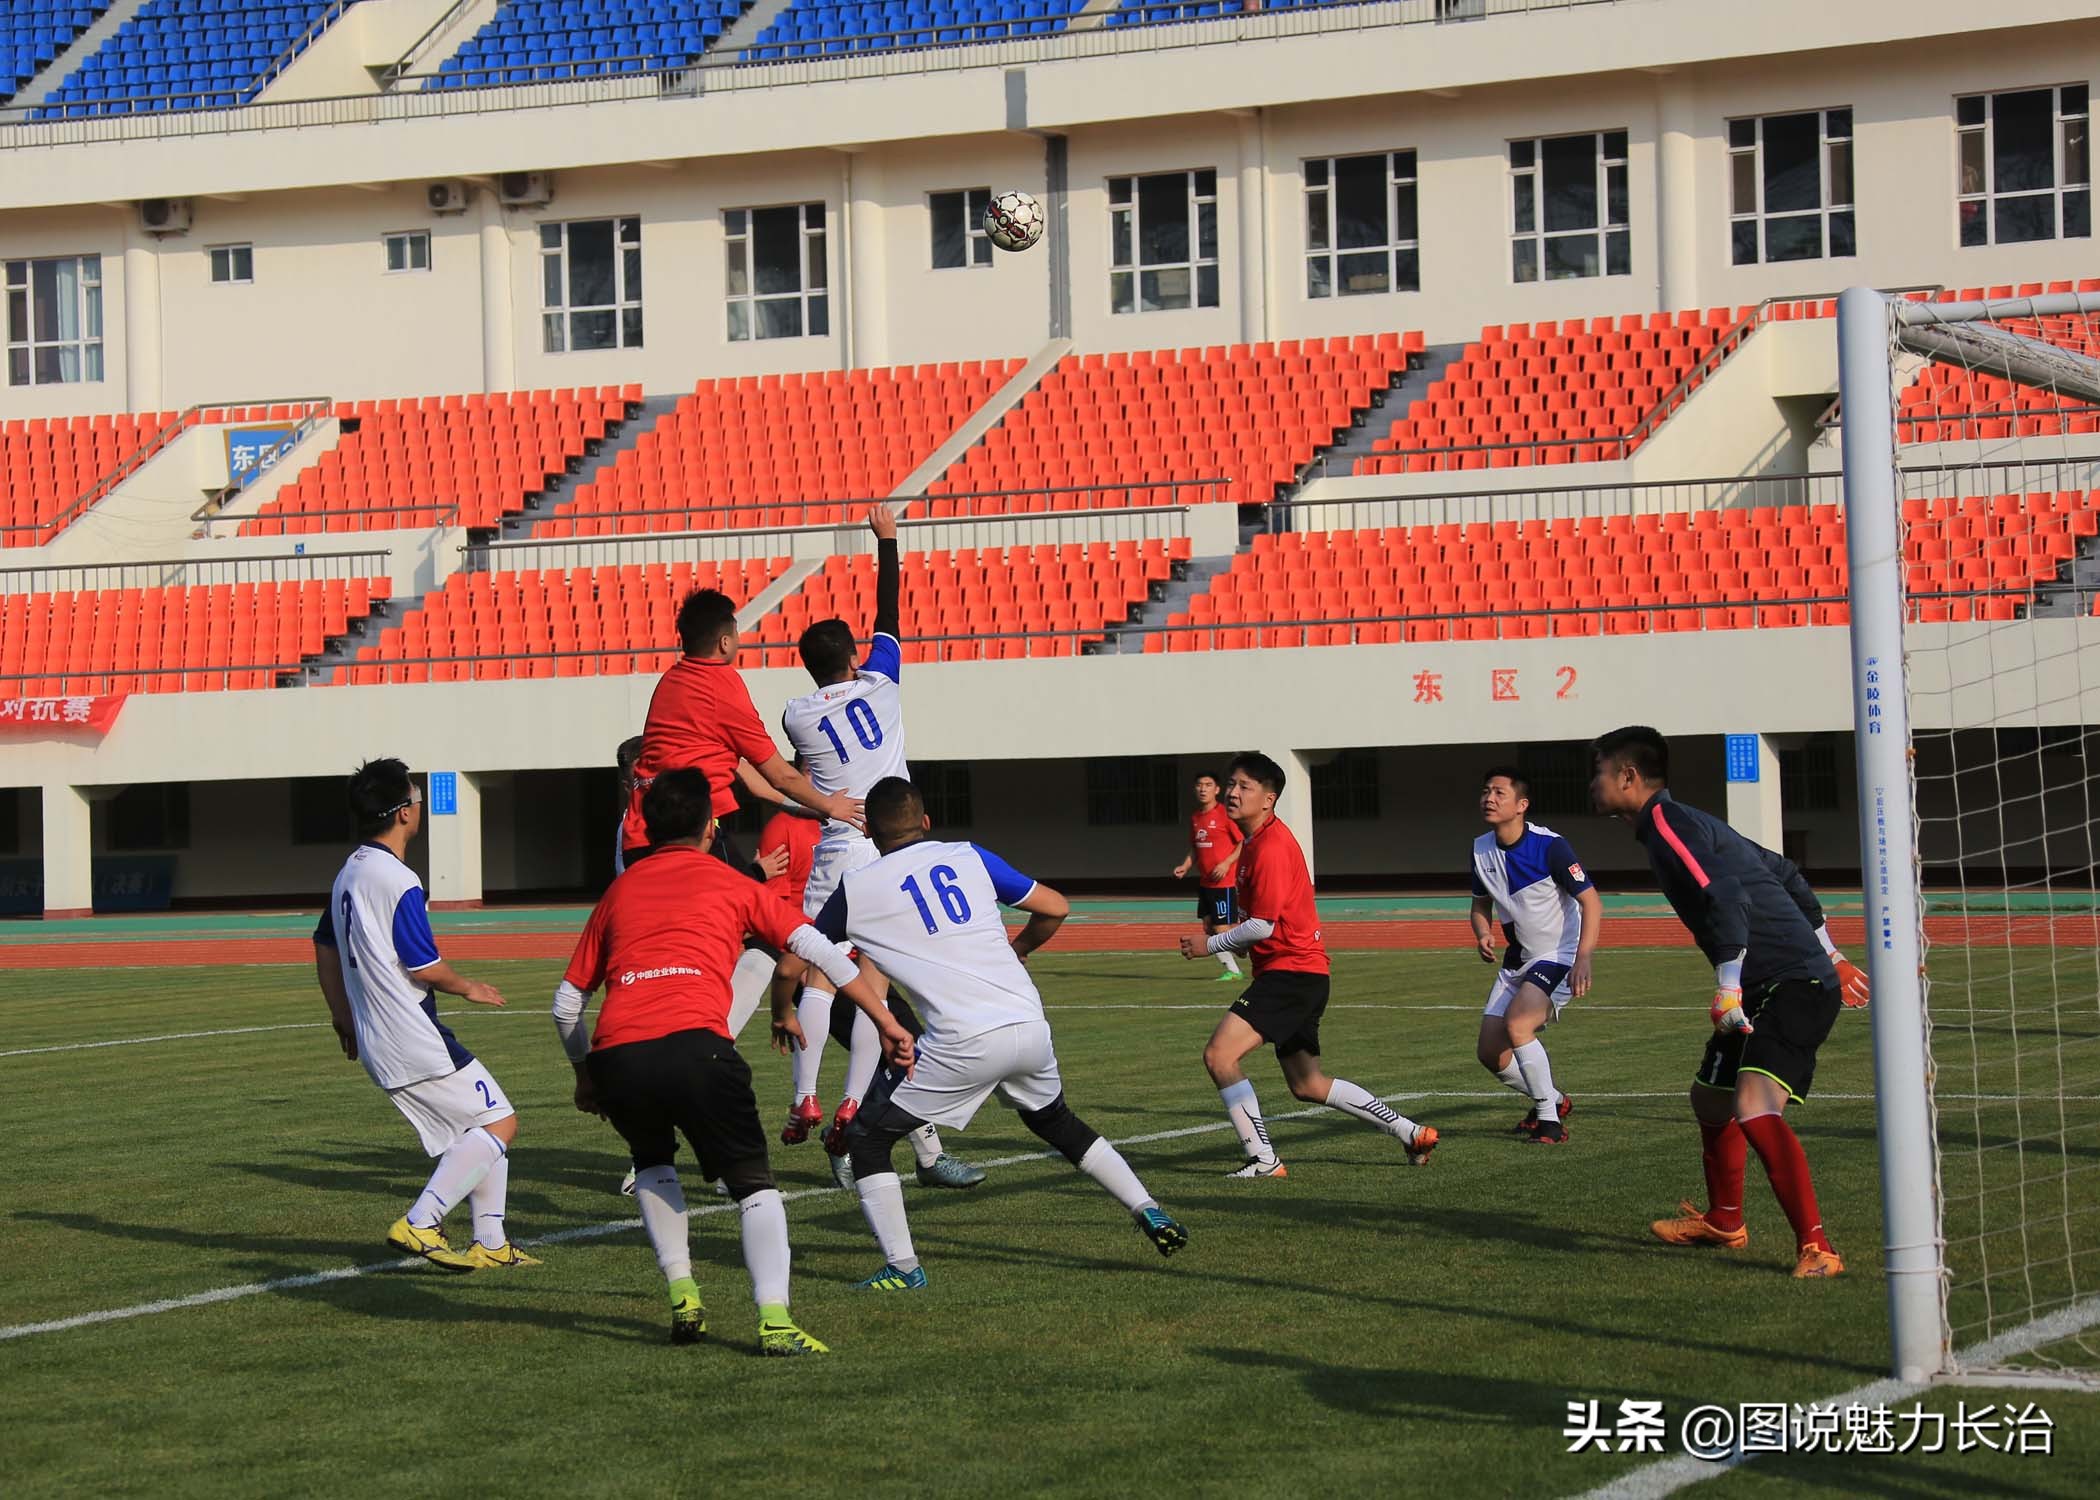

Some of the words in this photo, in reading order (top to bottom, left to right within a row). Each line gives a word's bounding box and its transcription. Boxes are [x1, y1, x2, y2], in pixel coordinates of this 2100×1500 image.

[817, 697, 883, 765] 10
[1866, 670, 1881, 735] 金陵体育
[341, 889, 358, 969] 2
[899, 864, 972, 936] 16
[1216, 900, 1227, 916] 10
[475, 1079, 497, 1109] 2
